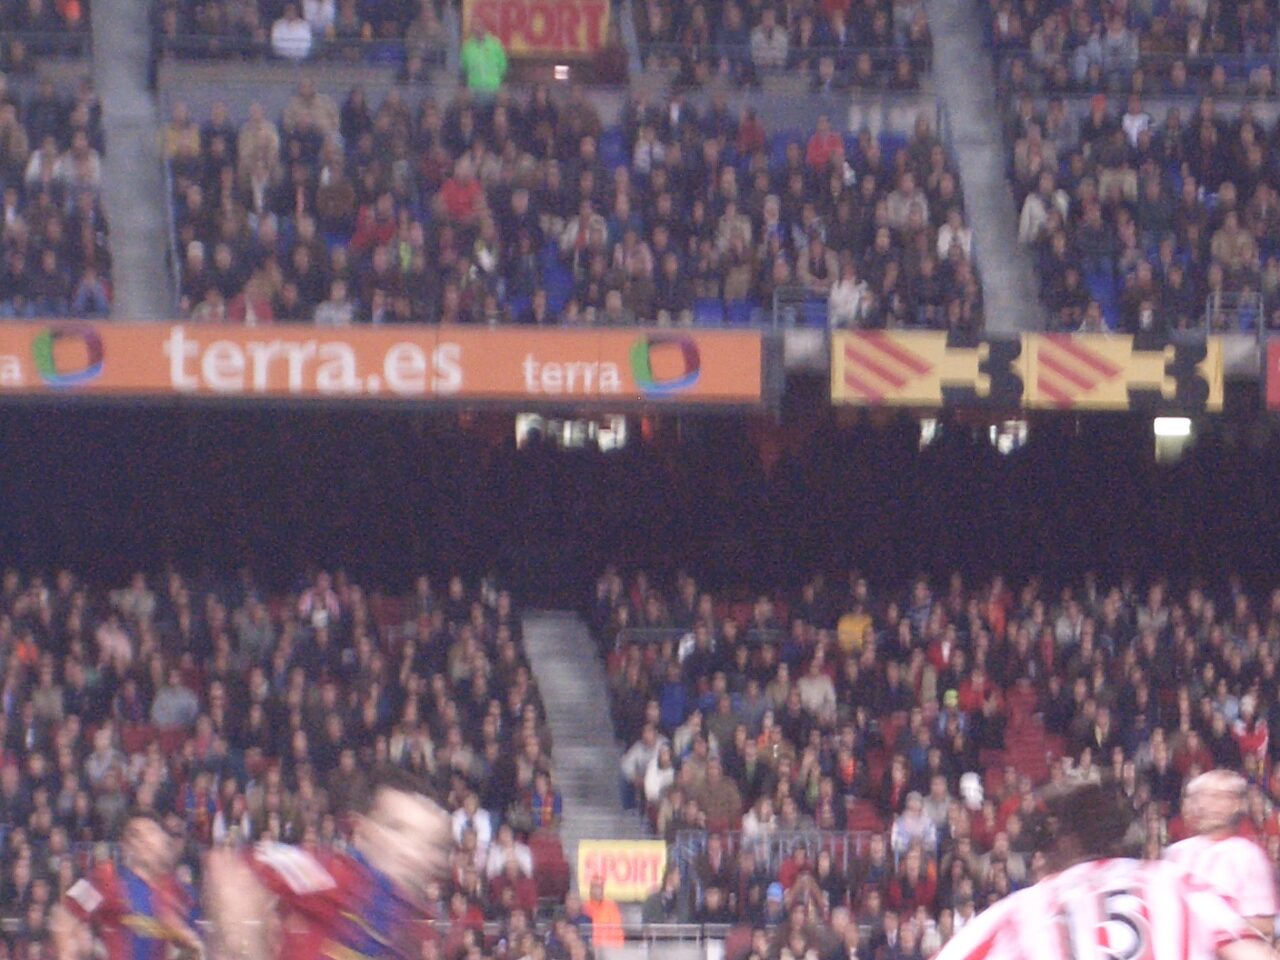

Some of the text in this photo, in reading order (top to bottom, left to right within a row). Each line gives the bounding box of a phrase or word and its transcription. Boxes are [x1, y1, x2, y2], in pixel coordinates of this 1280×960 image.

[465, 0, 607, 50] SPORT
[163, 325, 463, 394] terra.es
[522, 352, 621, 394] terra
[585, 852, 662, 885] SPORT
